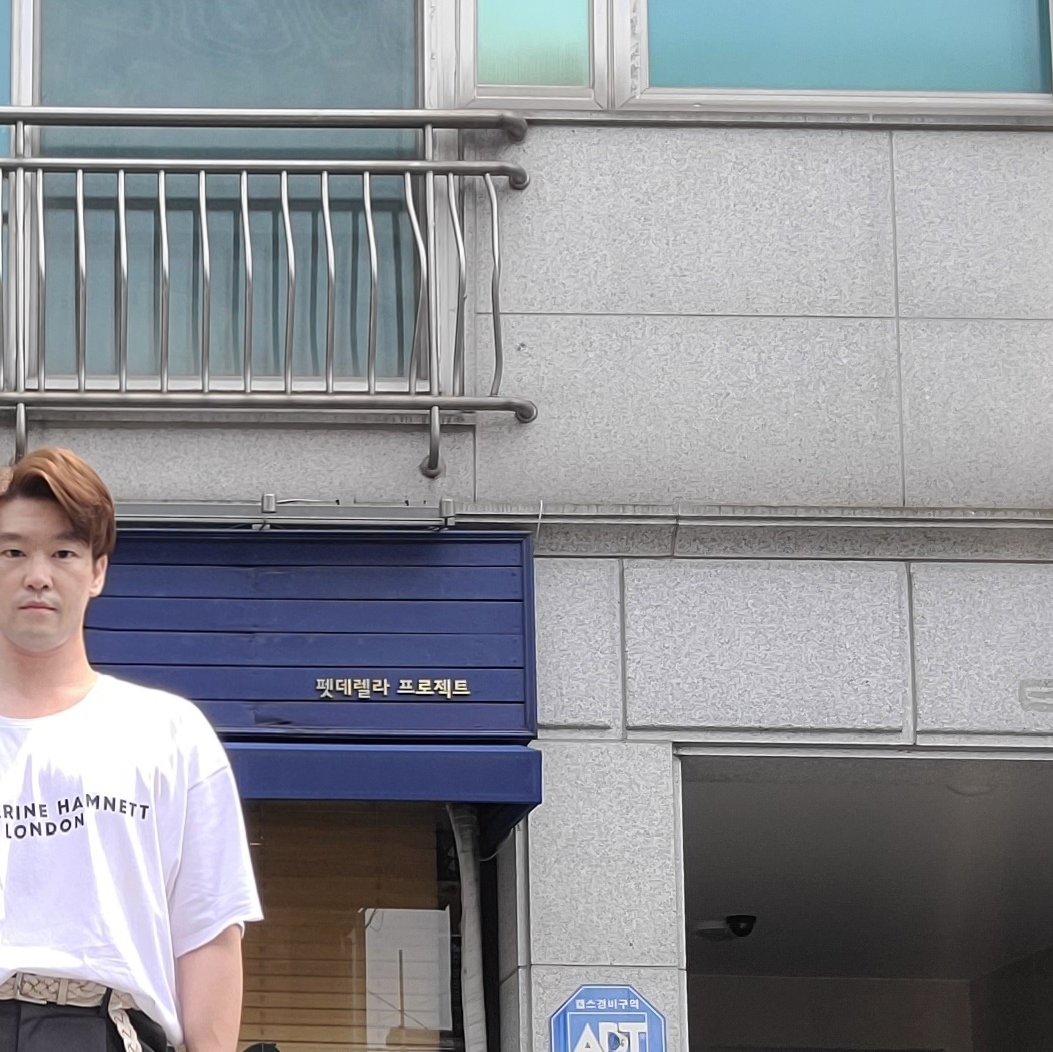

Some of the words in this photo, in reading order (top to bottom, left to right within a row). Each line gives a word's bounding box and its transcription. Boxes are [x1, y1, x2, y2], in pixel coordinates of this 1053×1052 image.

[315, 678, 390, 699] 펫데렐라
[396, 678, 471, 699] 프로젝트
[57, 793, 150, 820] HAMNETT
[5, 812, 85, 839] LONDON
